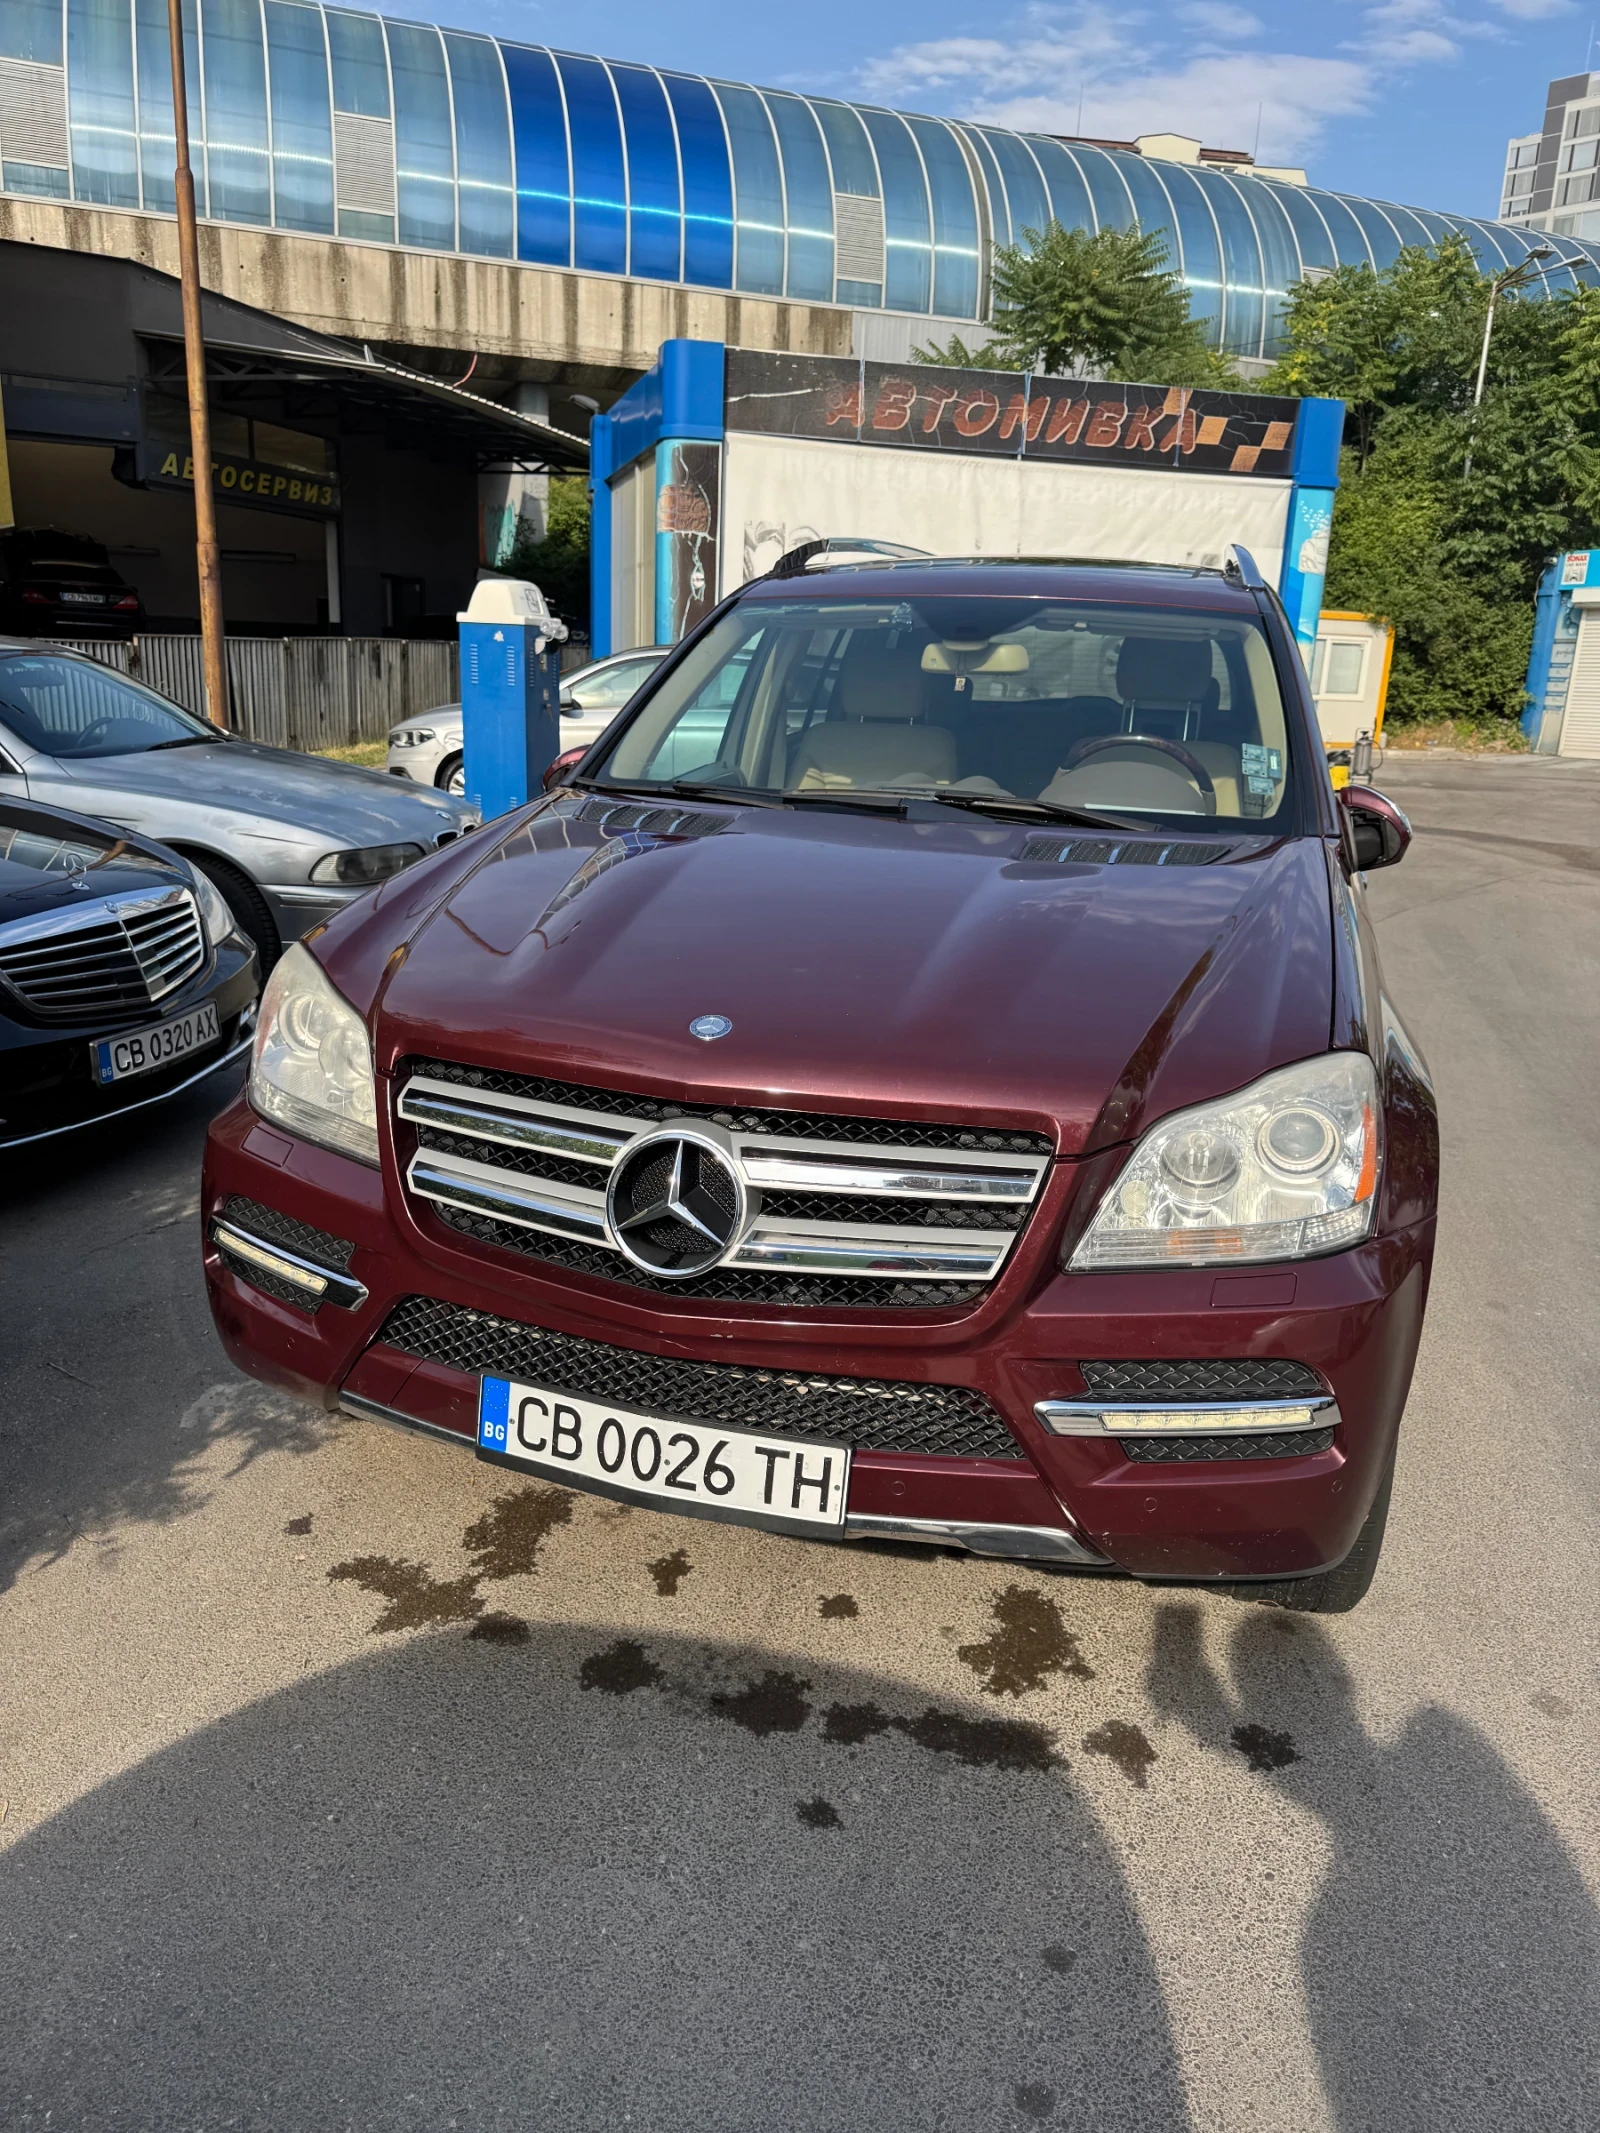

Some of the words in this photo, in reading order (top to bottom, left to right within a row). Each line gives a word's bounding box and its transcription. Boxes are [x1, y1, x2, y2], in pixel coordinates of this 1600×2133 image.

[825, 379, 1197, 455] АВТОМИВКА
[102, 1066, 112, 1077] BG
[114, 1038, 145, 1072] CB
[150, 1020, 193, 1060] 0320
[196, 1008, 217, 1043] AX
[483, 1420, 505, 1441] BG
[516, 1396, 583, 1461] CB
[596, 1417, 736, 1496] 0026
[754, 1445, 833, 1513] TH
